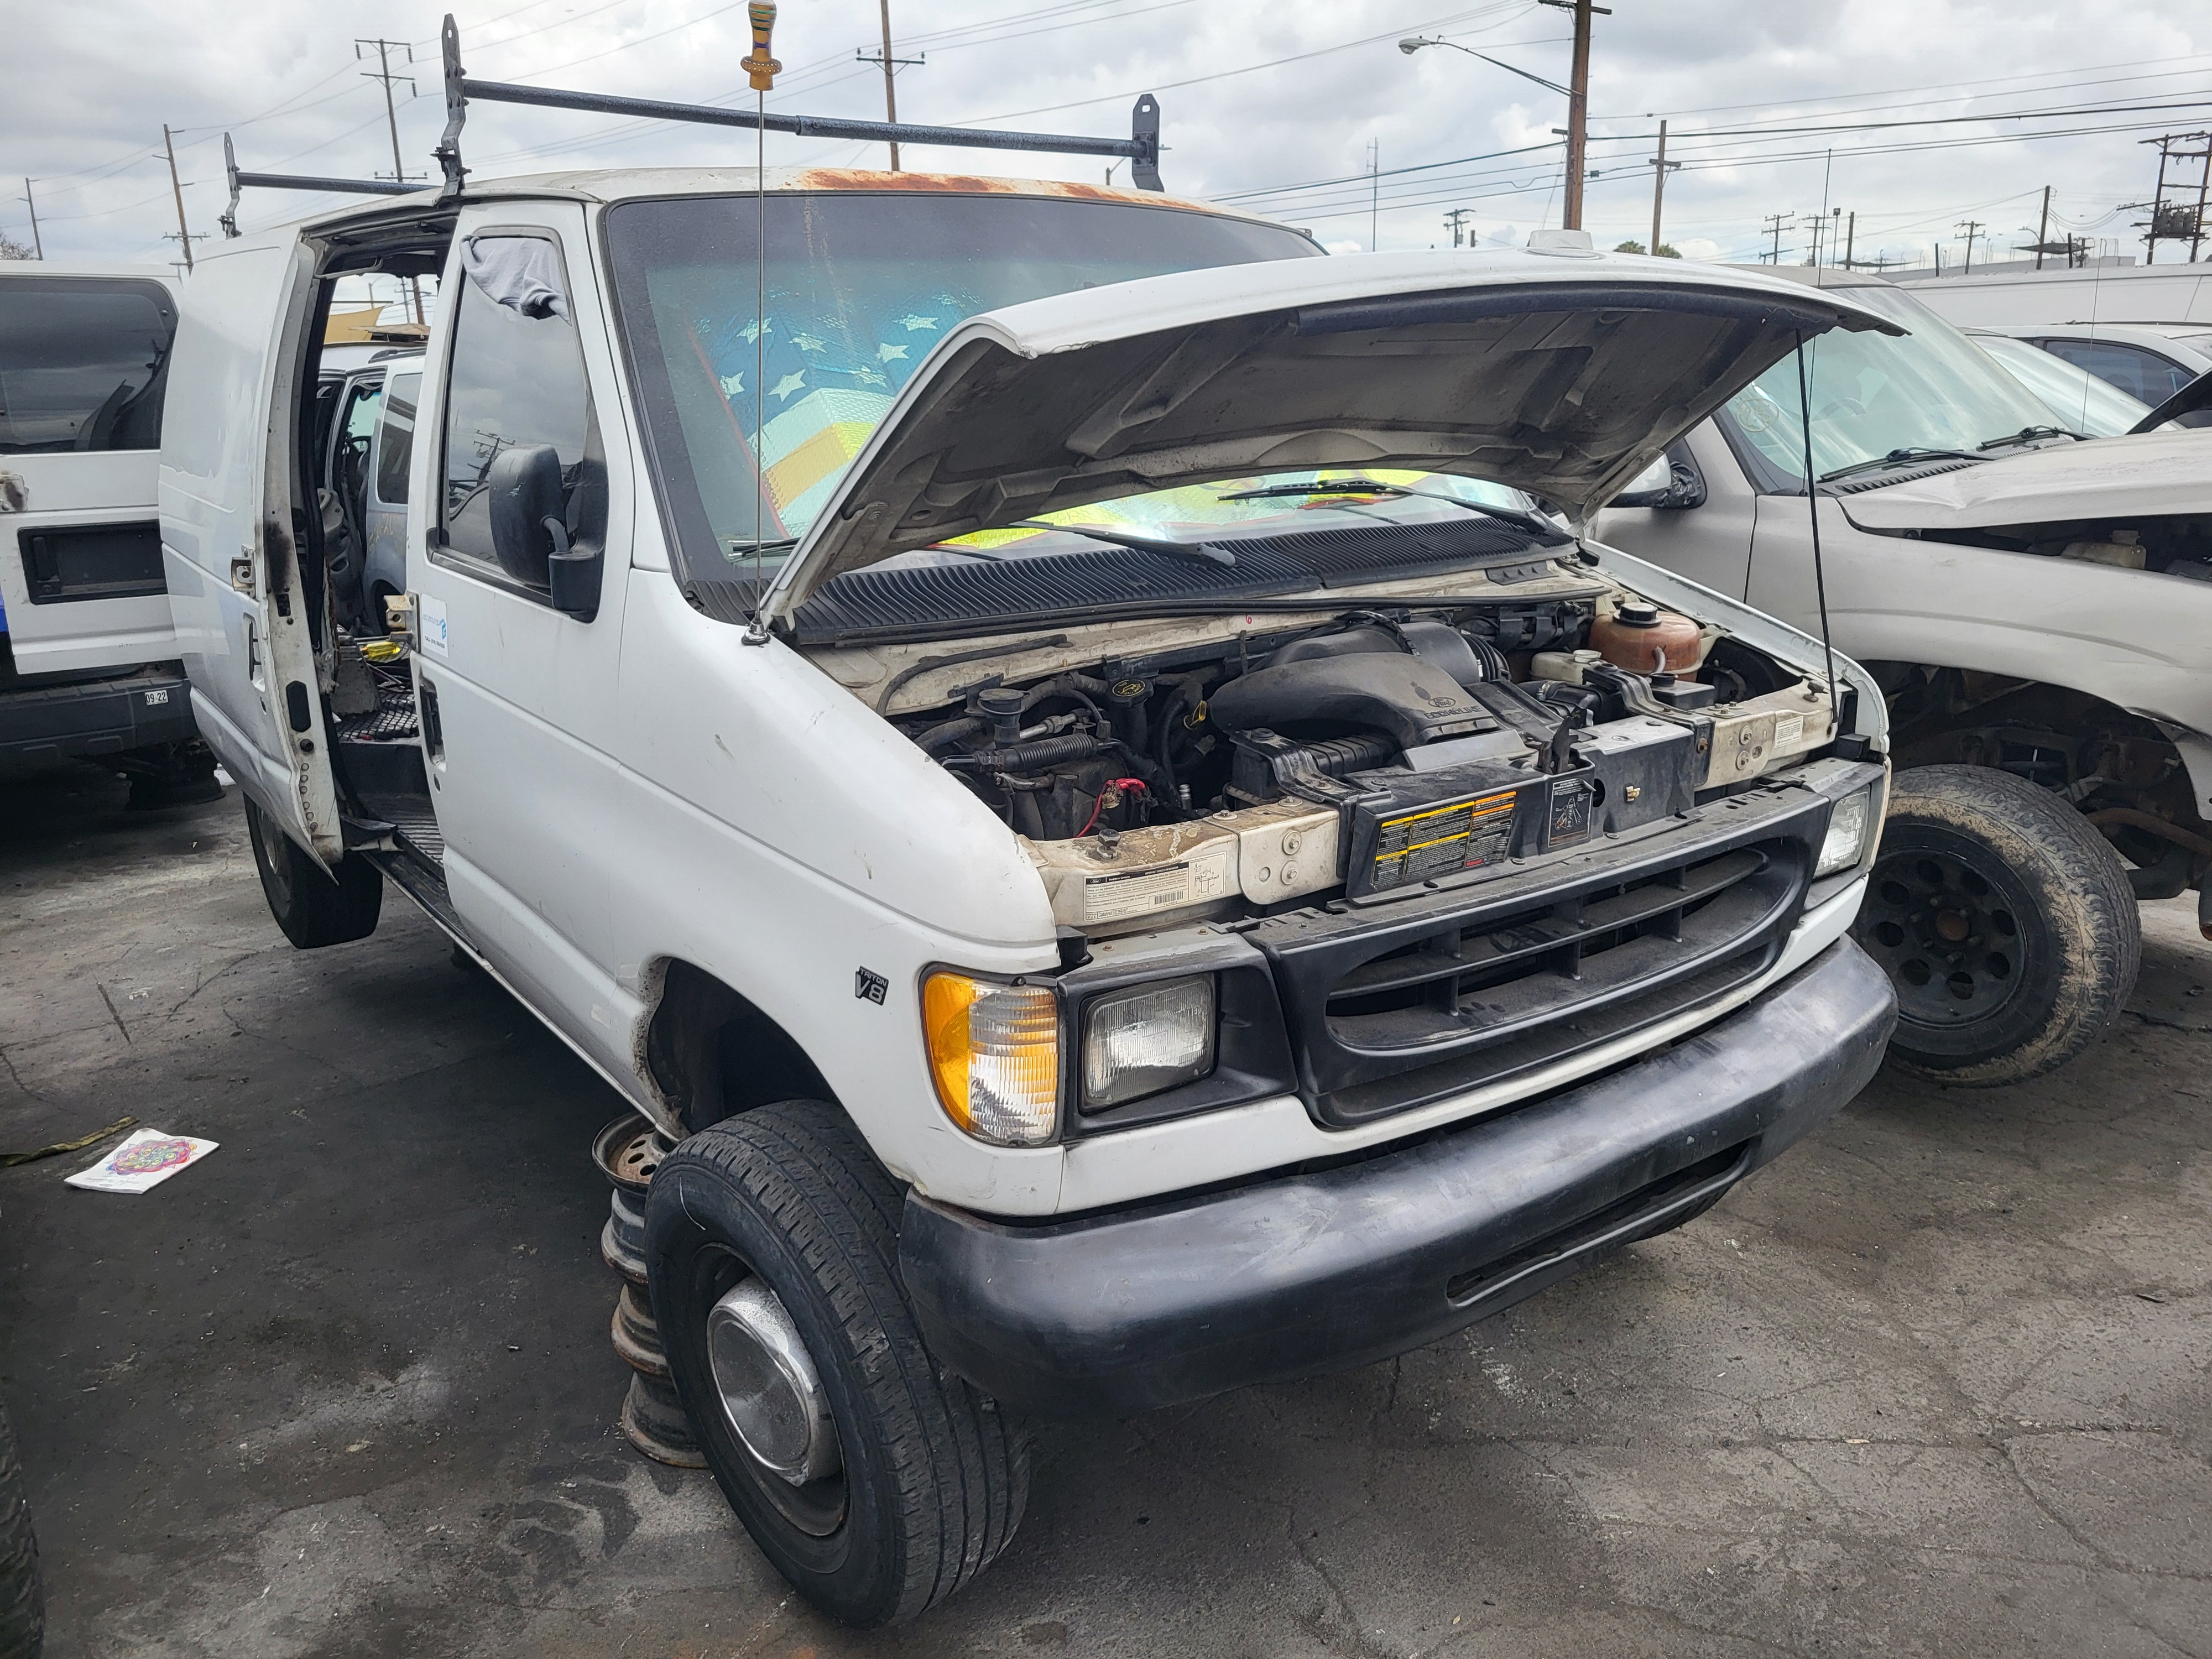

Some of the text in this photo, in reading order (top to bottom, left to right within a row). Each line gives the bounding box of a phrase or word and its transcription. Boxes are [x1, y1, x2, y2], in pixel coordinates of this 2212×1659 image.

[145, 692, 166, 703] 09 22
[1423, 706, 1483, 719] ECONOLINE
[860, 968, 888, 987] TRITON
[855, 973, 884, 1003] V8
